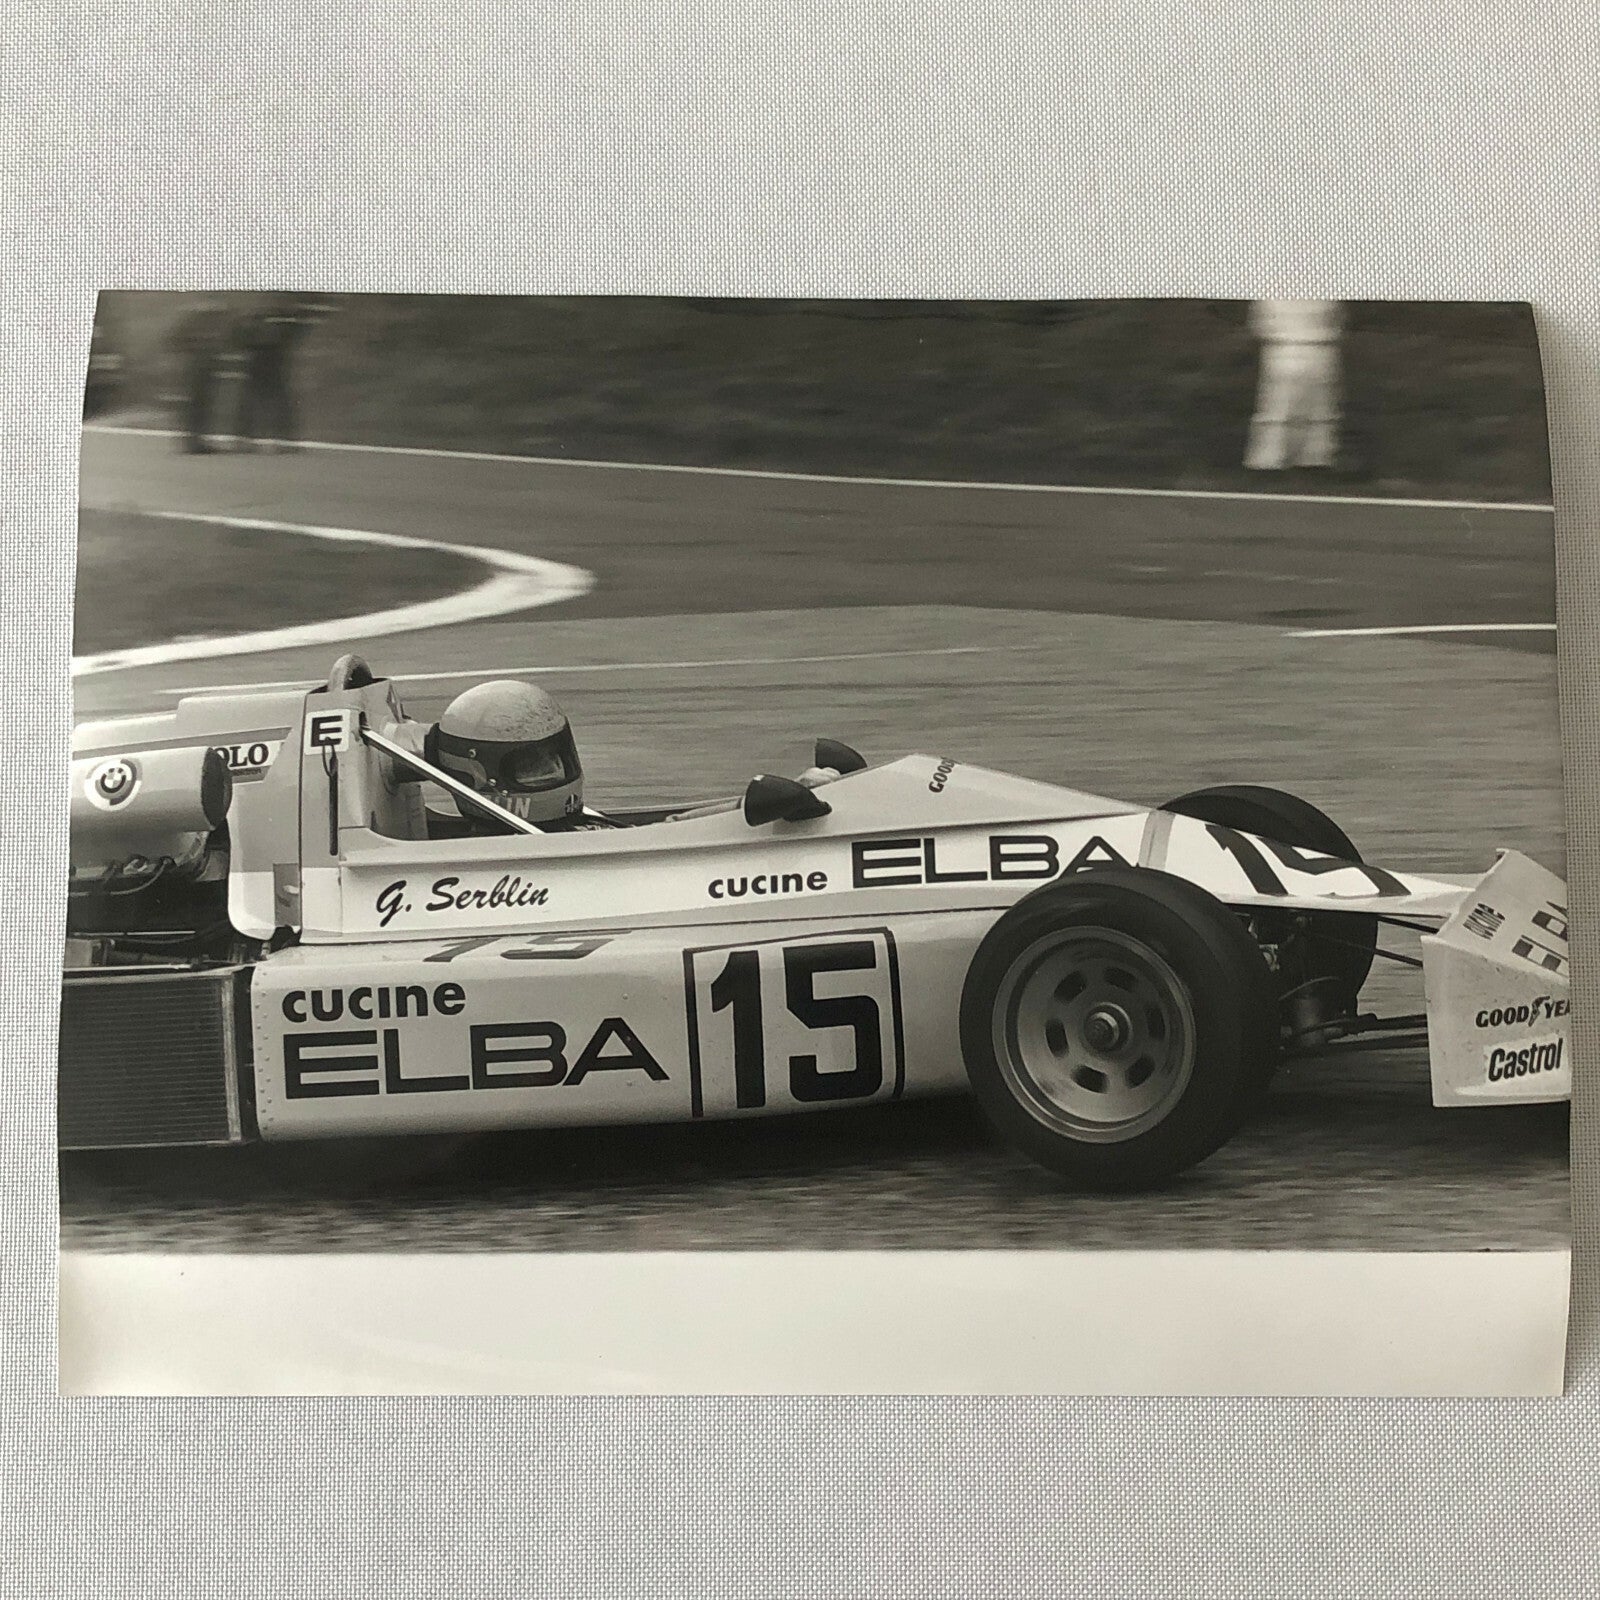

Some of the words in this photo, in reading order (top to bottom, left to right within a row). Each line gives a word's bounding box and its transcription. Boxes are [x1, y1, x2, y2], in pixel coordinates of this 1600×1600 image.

[311, 715, 343, 747] E
[709, 871, 828, 899] cucine
[851, 835, 1133, 888] ELBA
[376, 880, 412, 927] G.
[426, 875, 549, 911] Serblin
[281, 982, 466, 1023] cucine
[710, 940, 883, 1110] 15
[282, 1016, 671, 1100] ELBA
[1488, 1038, 1563, 1082] Castrol
